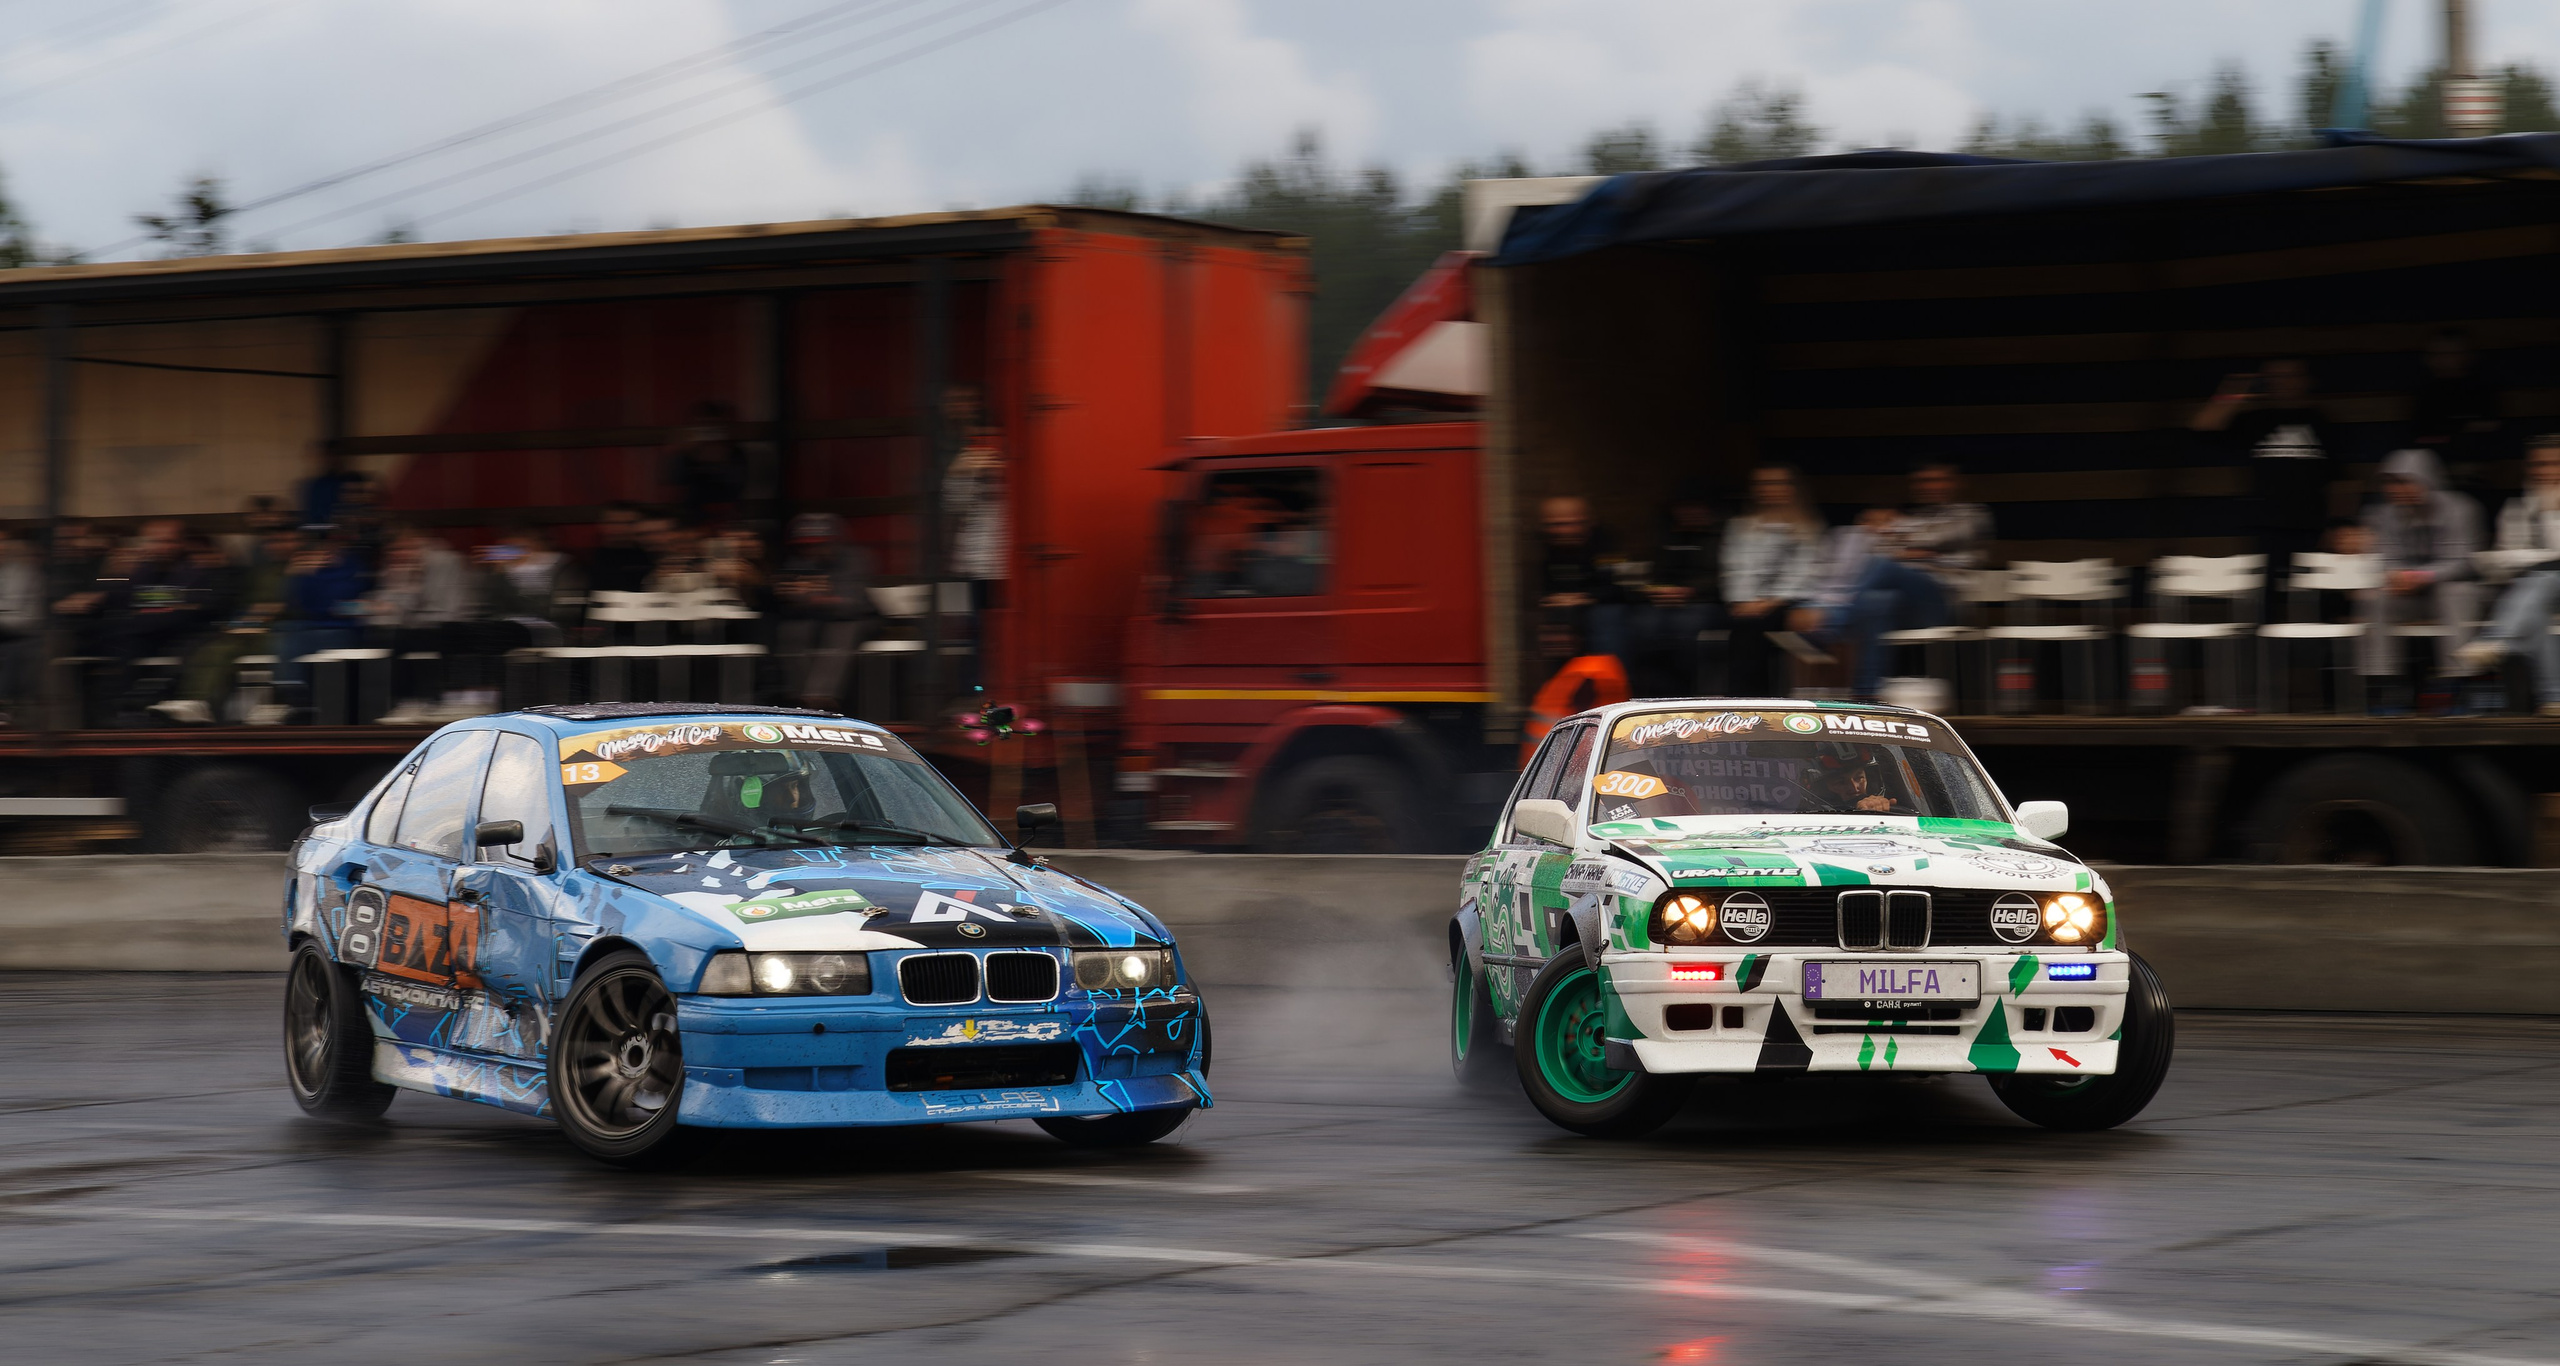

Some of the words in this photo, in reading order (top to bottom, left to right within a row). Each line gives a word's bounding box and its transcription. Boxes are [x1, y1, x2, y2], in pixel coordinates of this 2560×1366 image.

[781, 725, 884, 747] Мега
[1631, 718, 1684, 744] Mega
[1677, 712, 1723, 738] Drift
[1722, 712, 1762, 733] Cup
[1824, 715, 1929, 737] Мега
[597, 733, 650, 760] Mega
[643, 725, 689, 752] Drift
[688, 725, 722, 745] Cup
[564, 764, 600, 782] 13
[1601, 773, 1656, 797] 300
[780, 896, 862, 910] Мега
[1723, 908, 1767, 923] Hella
[1993, 909, 2037, 924] Hella
[1859, 969, 1941, 994] MILFA
[1876, 1000, 1902, 1009] САНЯ
